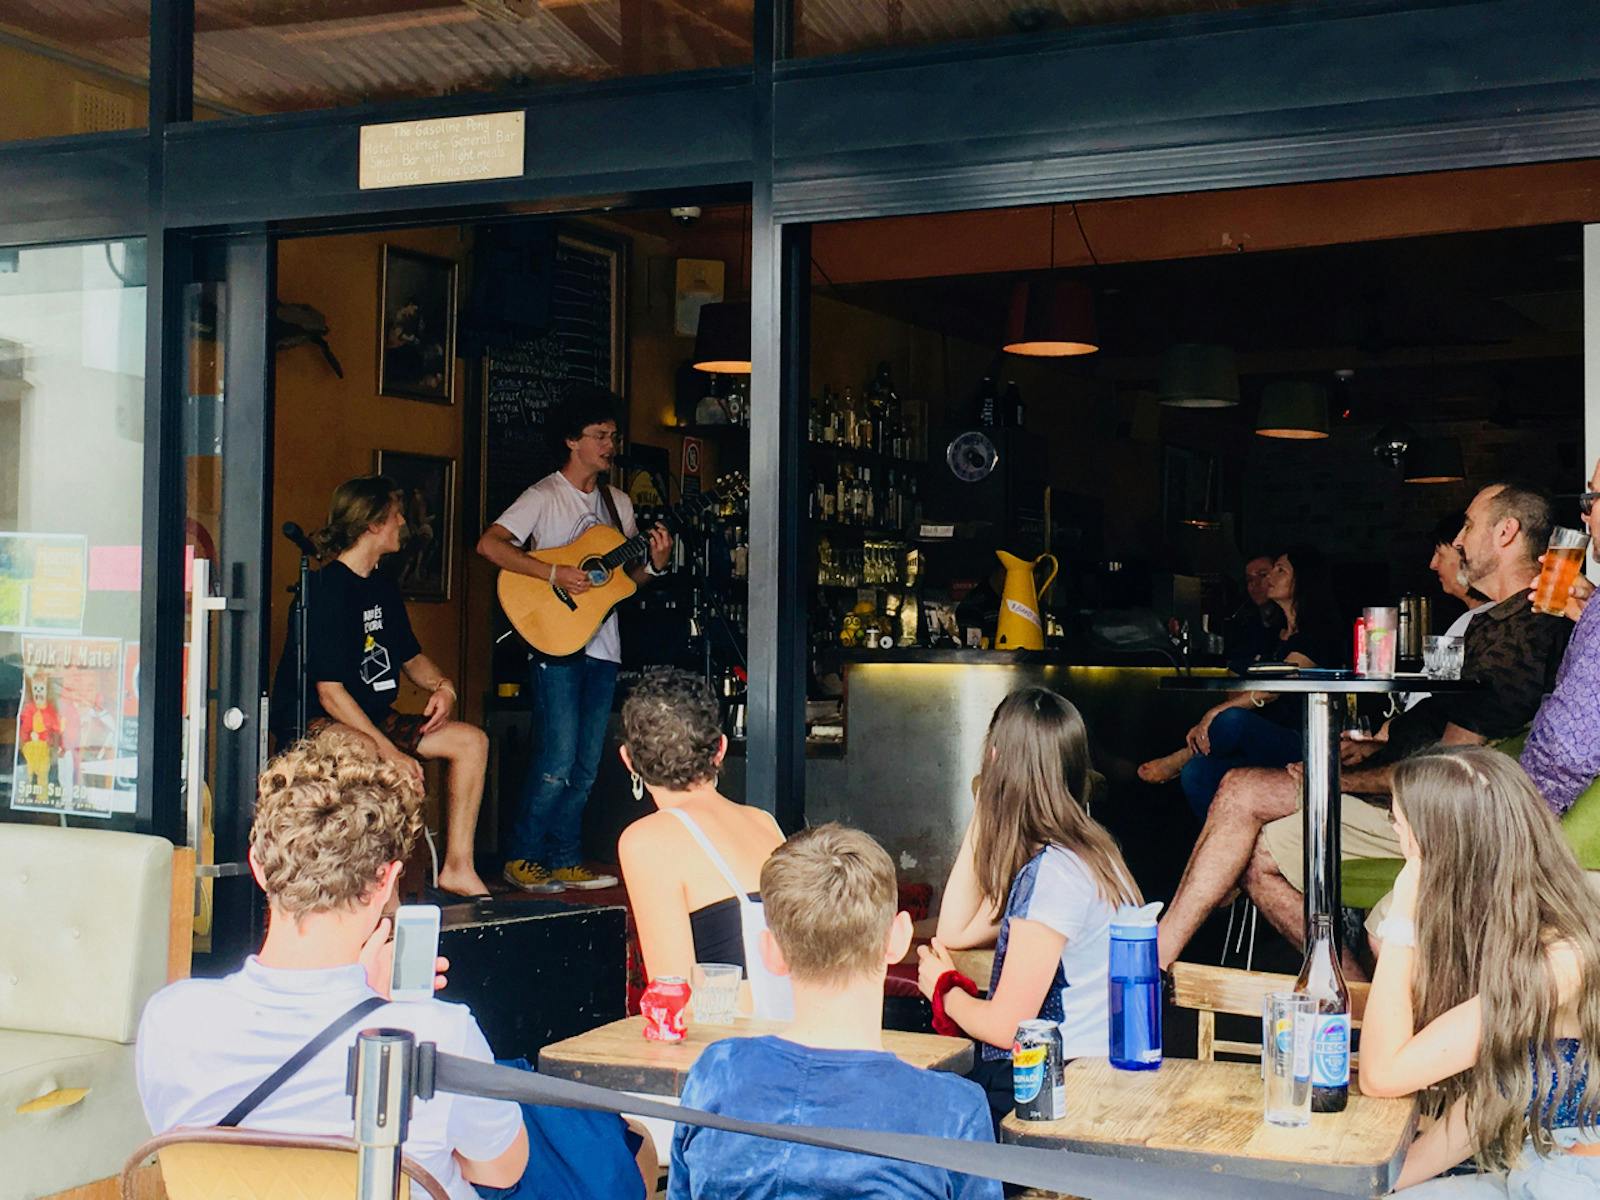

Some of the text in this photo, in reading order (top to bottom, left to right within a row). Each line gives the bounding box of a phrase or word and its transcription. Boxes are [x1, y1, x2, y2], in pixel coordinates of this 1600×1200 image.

[392, 117, 490, 137] The Gasoline Pony
[364, 142, 393, 155] Hotel
[450, 133, 490, 148] General
[495, 129, 517, 144] Bar
[370, 155, 398, 169] Small
[402, 153, 421, 166] Bar
[423, 150, 445, 164] with
[450, 147, 473, 164] light
[26, 642, 56, 665] Folk
[63, 644, 72, 666] U
[18, 780, 43, 798] 5pm
